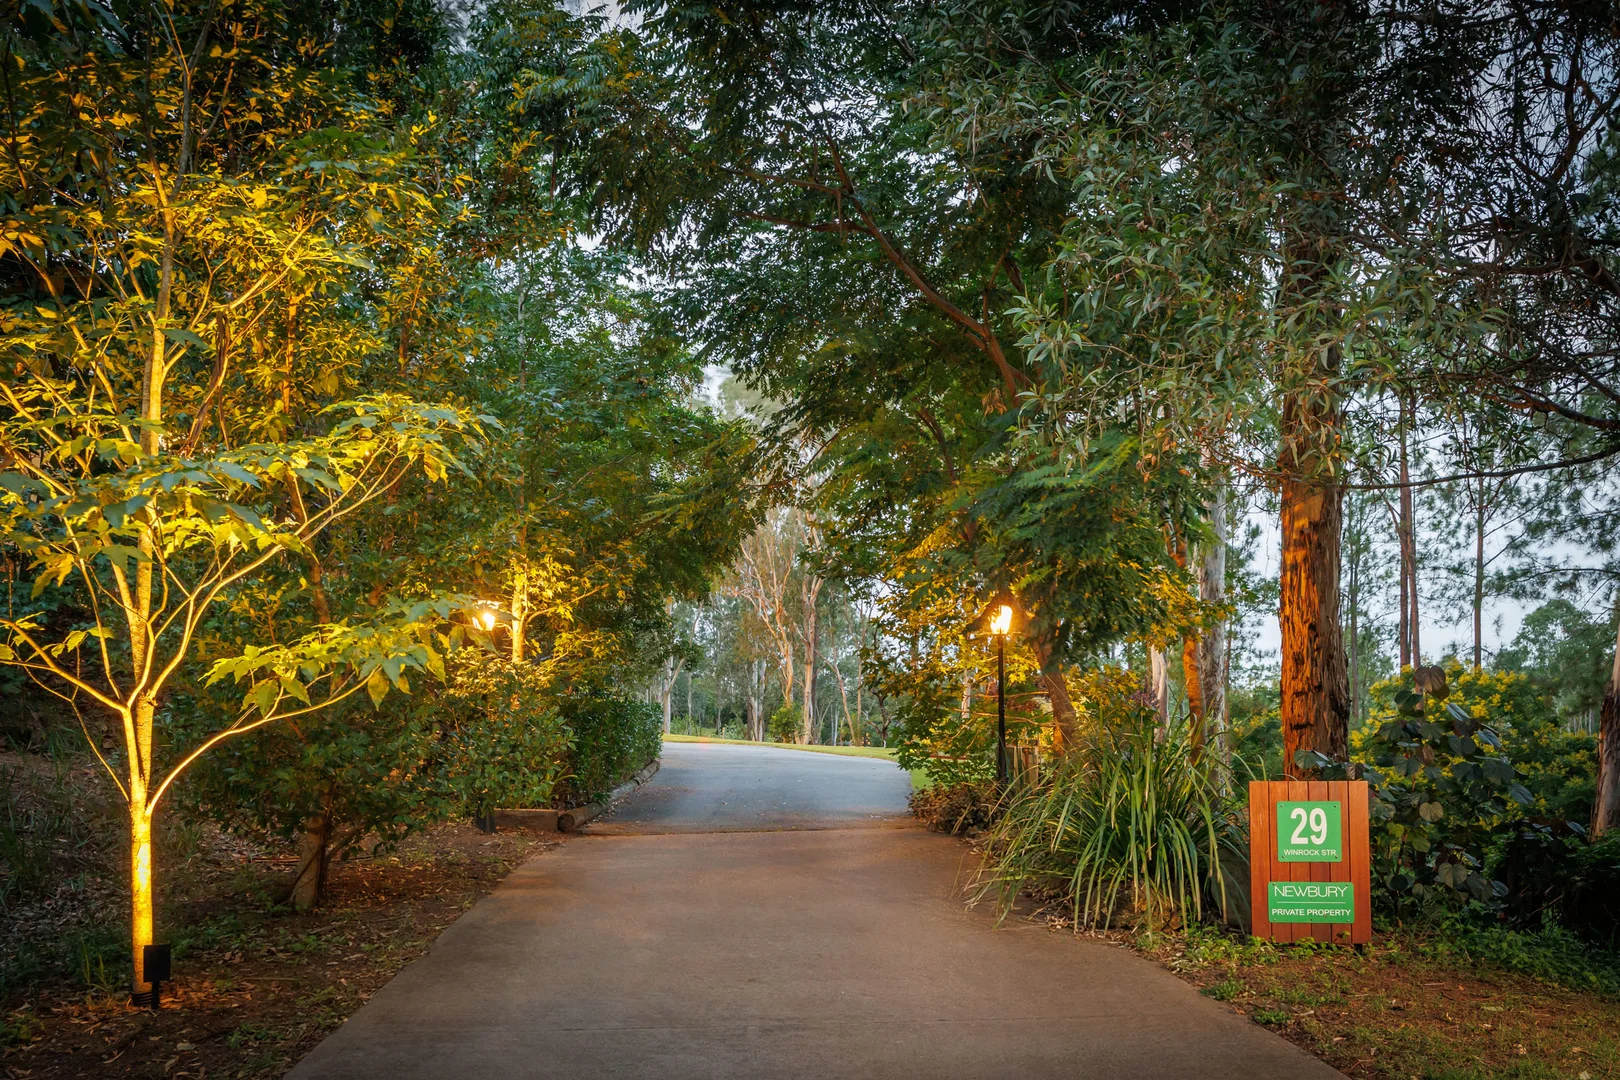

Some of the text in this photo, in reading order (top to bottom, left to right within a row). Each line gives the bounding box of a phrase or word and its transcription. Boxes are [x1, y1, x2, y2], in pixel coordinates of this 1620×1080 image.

[1290, 807, 1327, 845] 29
[1274, 885, 1348, 897] NEWBURY
[1271, 908, 1351, 916] PRIVATE PROPERTY
